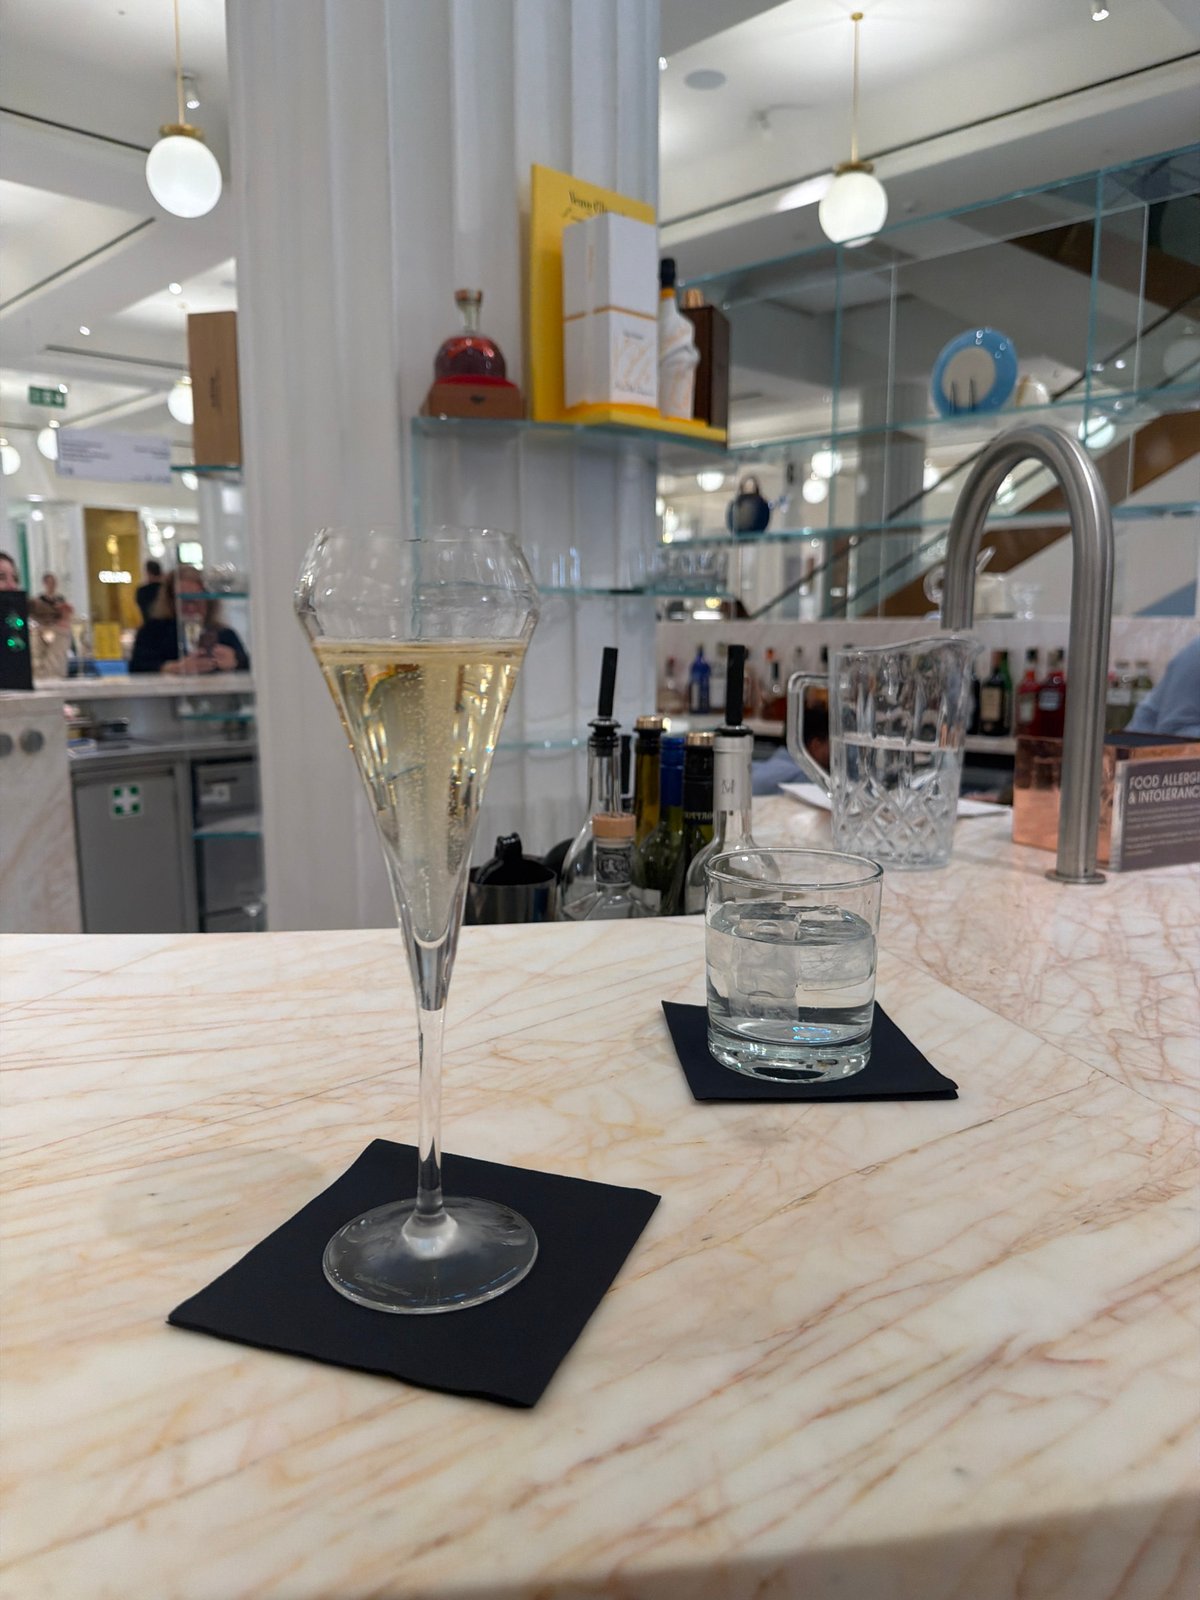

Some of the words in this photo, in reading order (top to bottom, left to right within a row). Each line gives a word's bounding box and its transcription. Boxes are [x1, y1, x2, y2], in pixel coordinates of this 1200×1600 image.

[721, 779, 735, 794] M
[1129, 774, 1160, 790] FOOD
[1127, 791, 1136, 805] &
[1138, 785, 1200, 803] INTOLERANC
